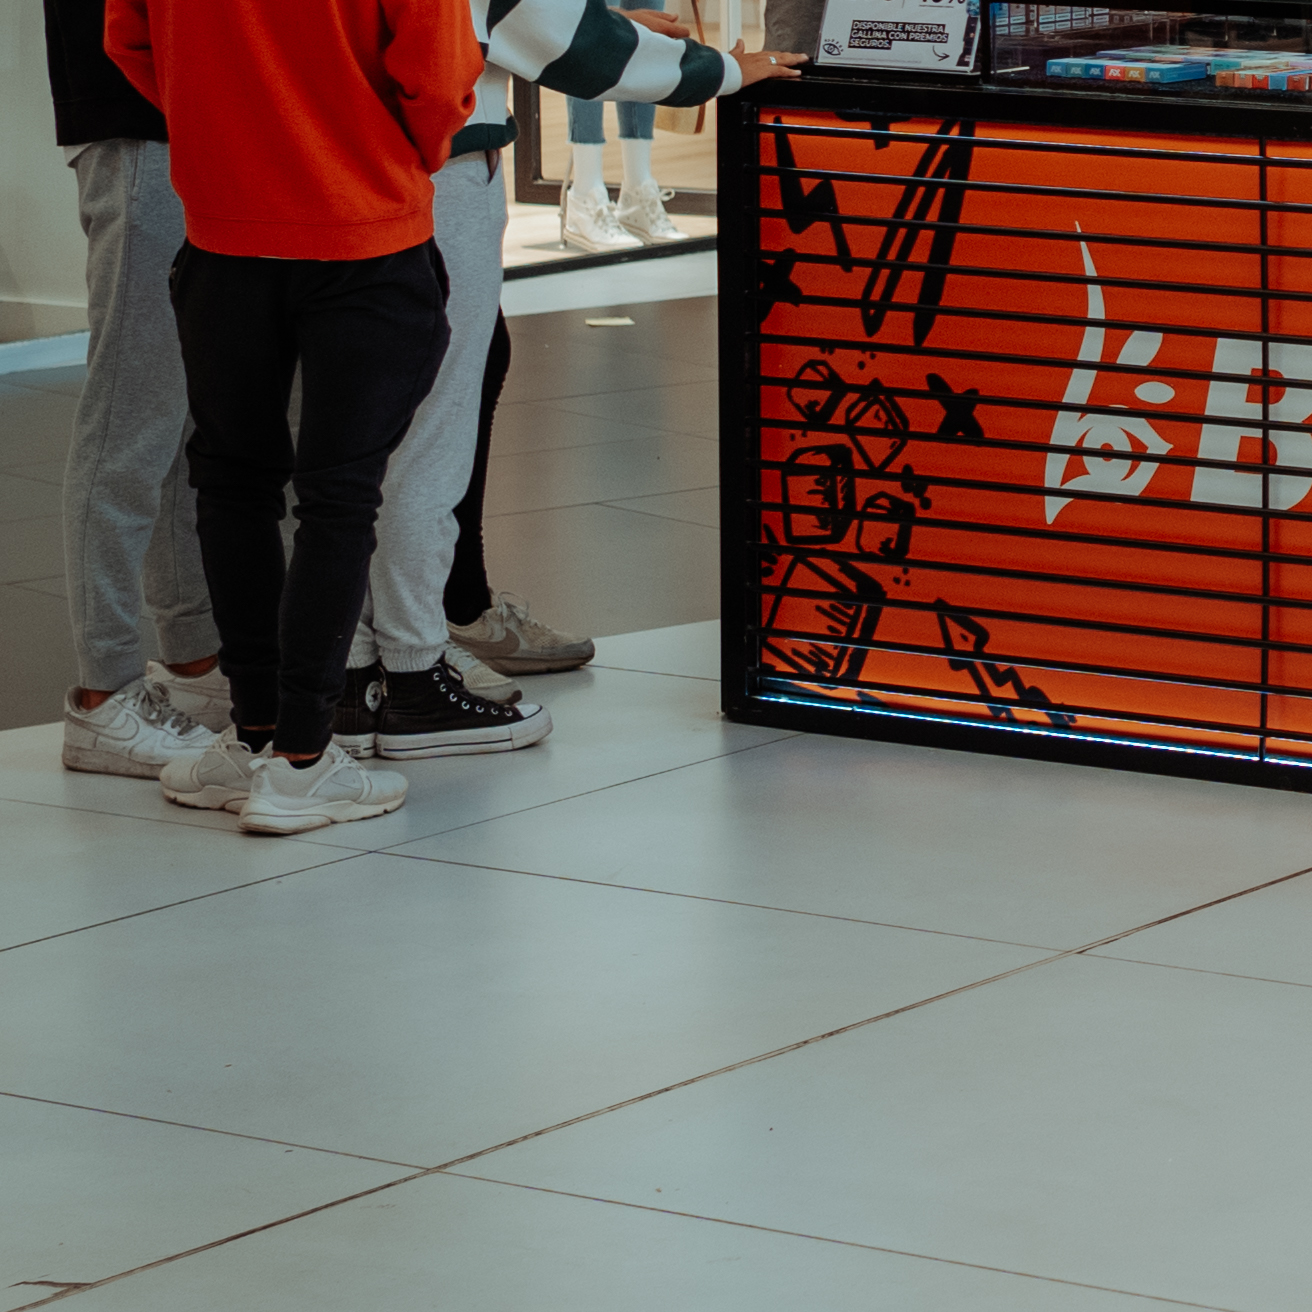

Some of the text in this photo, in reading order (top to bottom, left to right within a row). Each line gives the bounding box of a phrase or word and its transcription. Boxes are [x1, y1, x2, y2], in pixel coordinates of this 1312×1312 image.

[852, 21, 945, 33] DISPONIBLE NUESTRA
[851, 30, 948, 42] GALLINA CON PREMIOS
